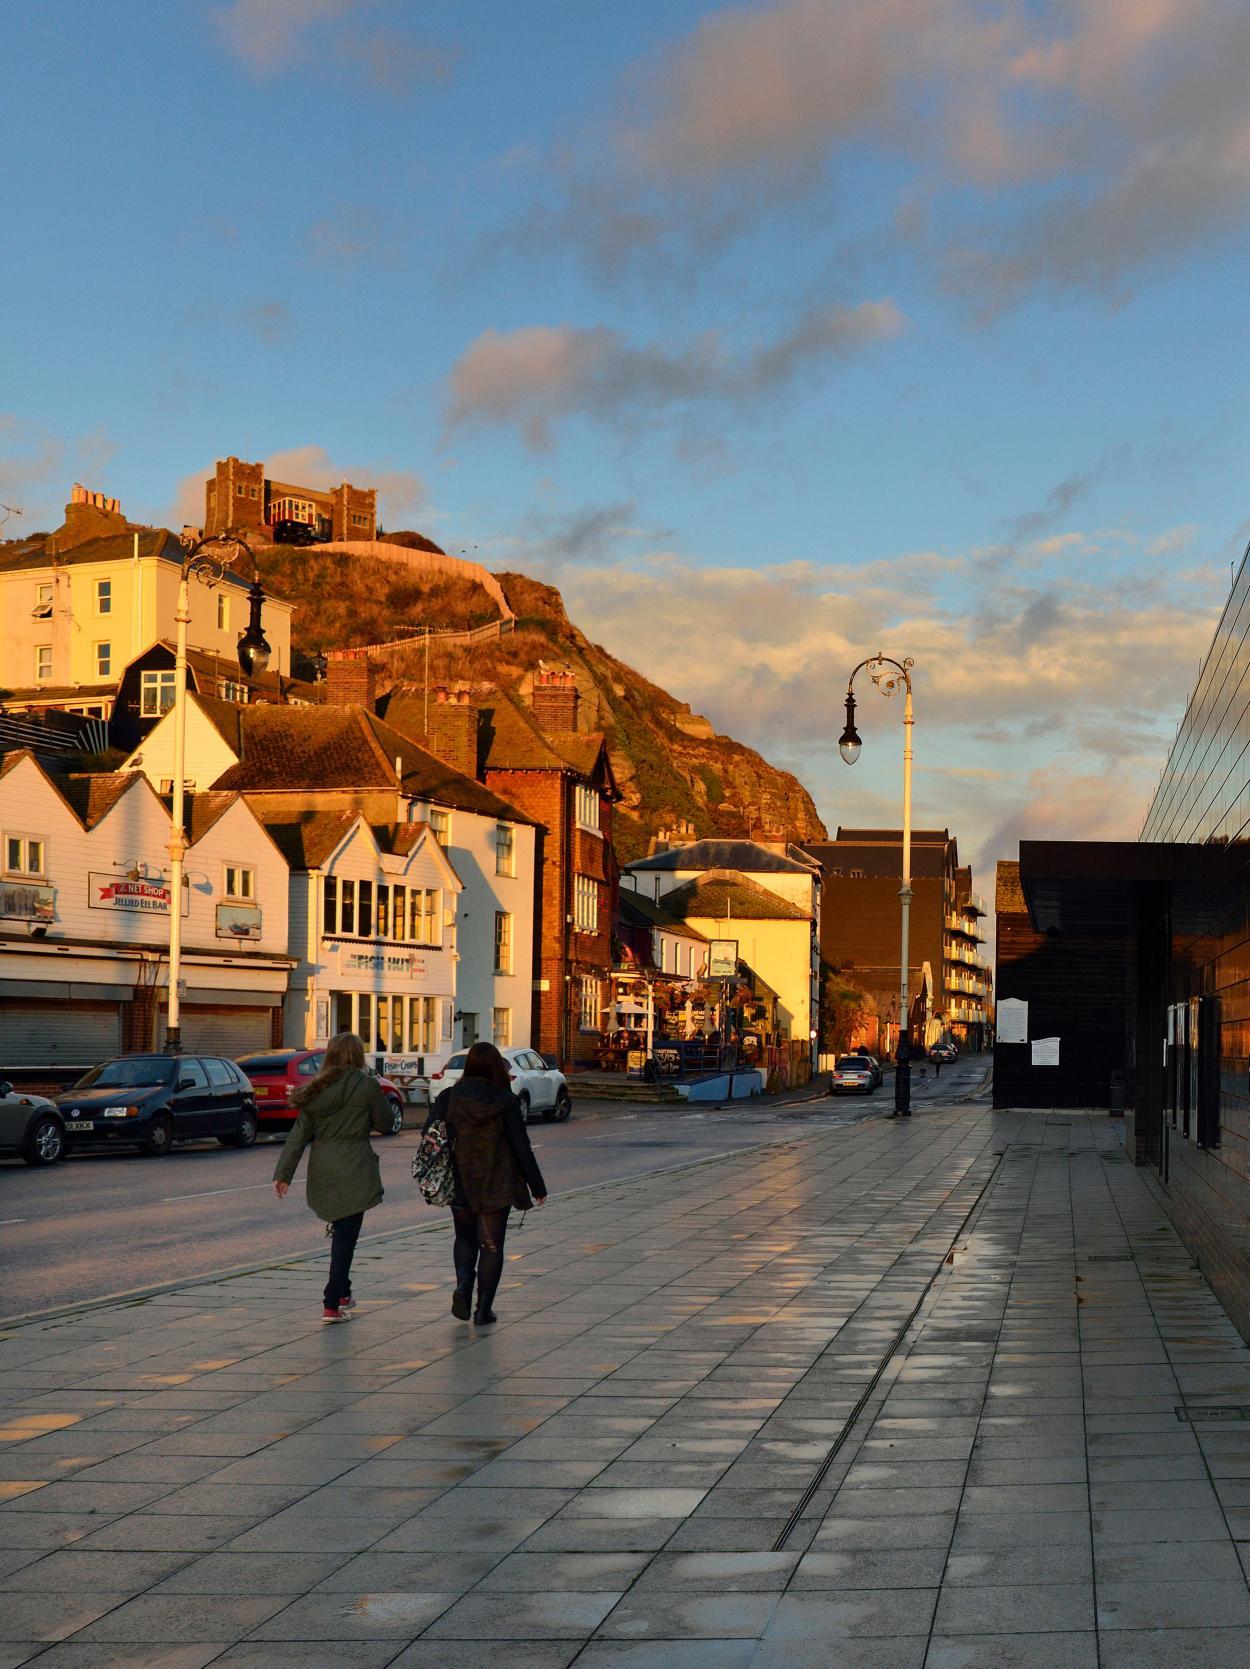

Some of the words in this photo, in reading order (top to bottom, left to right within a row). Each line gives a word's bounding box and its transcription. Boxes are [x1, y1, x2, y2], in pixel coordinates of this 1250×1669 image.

[128, 884, 142, 893] NET
[143, 885, 164, 897] SHOP
[113, 896, 140, 908] JELLIED
[152, 900, 168, 911] BAR
